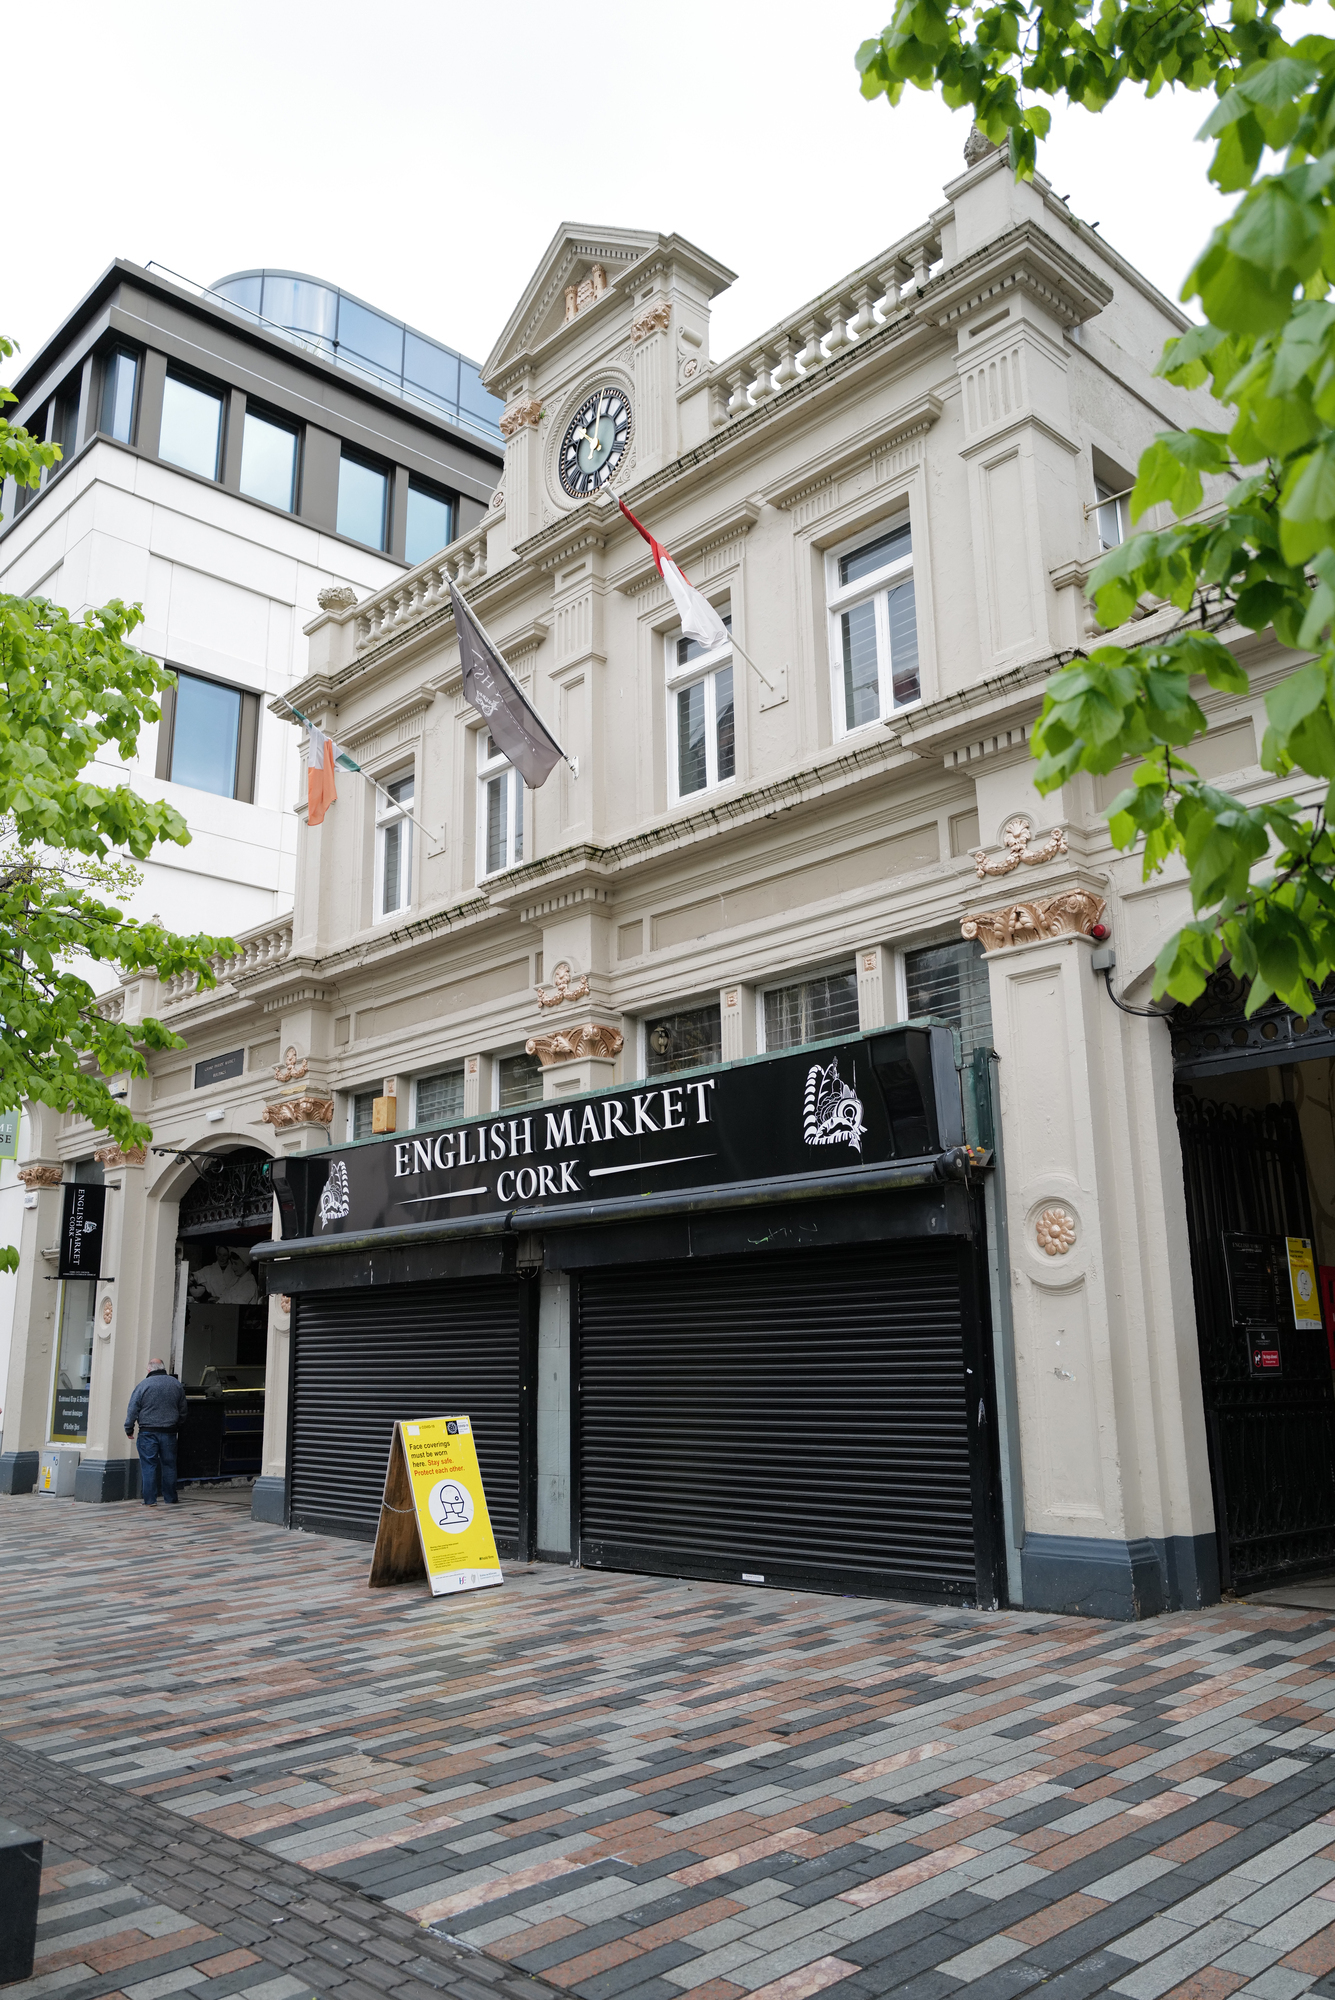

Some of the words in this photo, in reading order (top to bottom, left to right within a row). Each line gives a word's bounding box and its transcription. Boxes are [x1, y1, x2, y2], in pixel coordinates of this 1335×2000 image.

[394, 1117, 534, 1178] ENGLISH
[544, 1079, 715, 1151] MARKET
[496, 1160, 582, 1203] CORK
[76, 1189, 86, 1227] ENGLISH
[73, 1229, 82, 1265] MARKET
[410, 1451, 426, 1459] must
[425, 1450, 433, 1458] be
[423, 1440, 451, 1449] coverings
[412, 1460, 427, 1468] here.
[427, 1459, 440, 1467] Stay
[440, 1457, 455, 1465] safe.
[414, 1468, 435, 1477] Protect
[435, 1466, 449, 1474] each
[449, 1464, 466, 1472] other.
